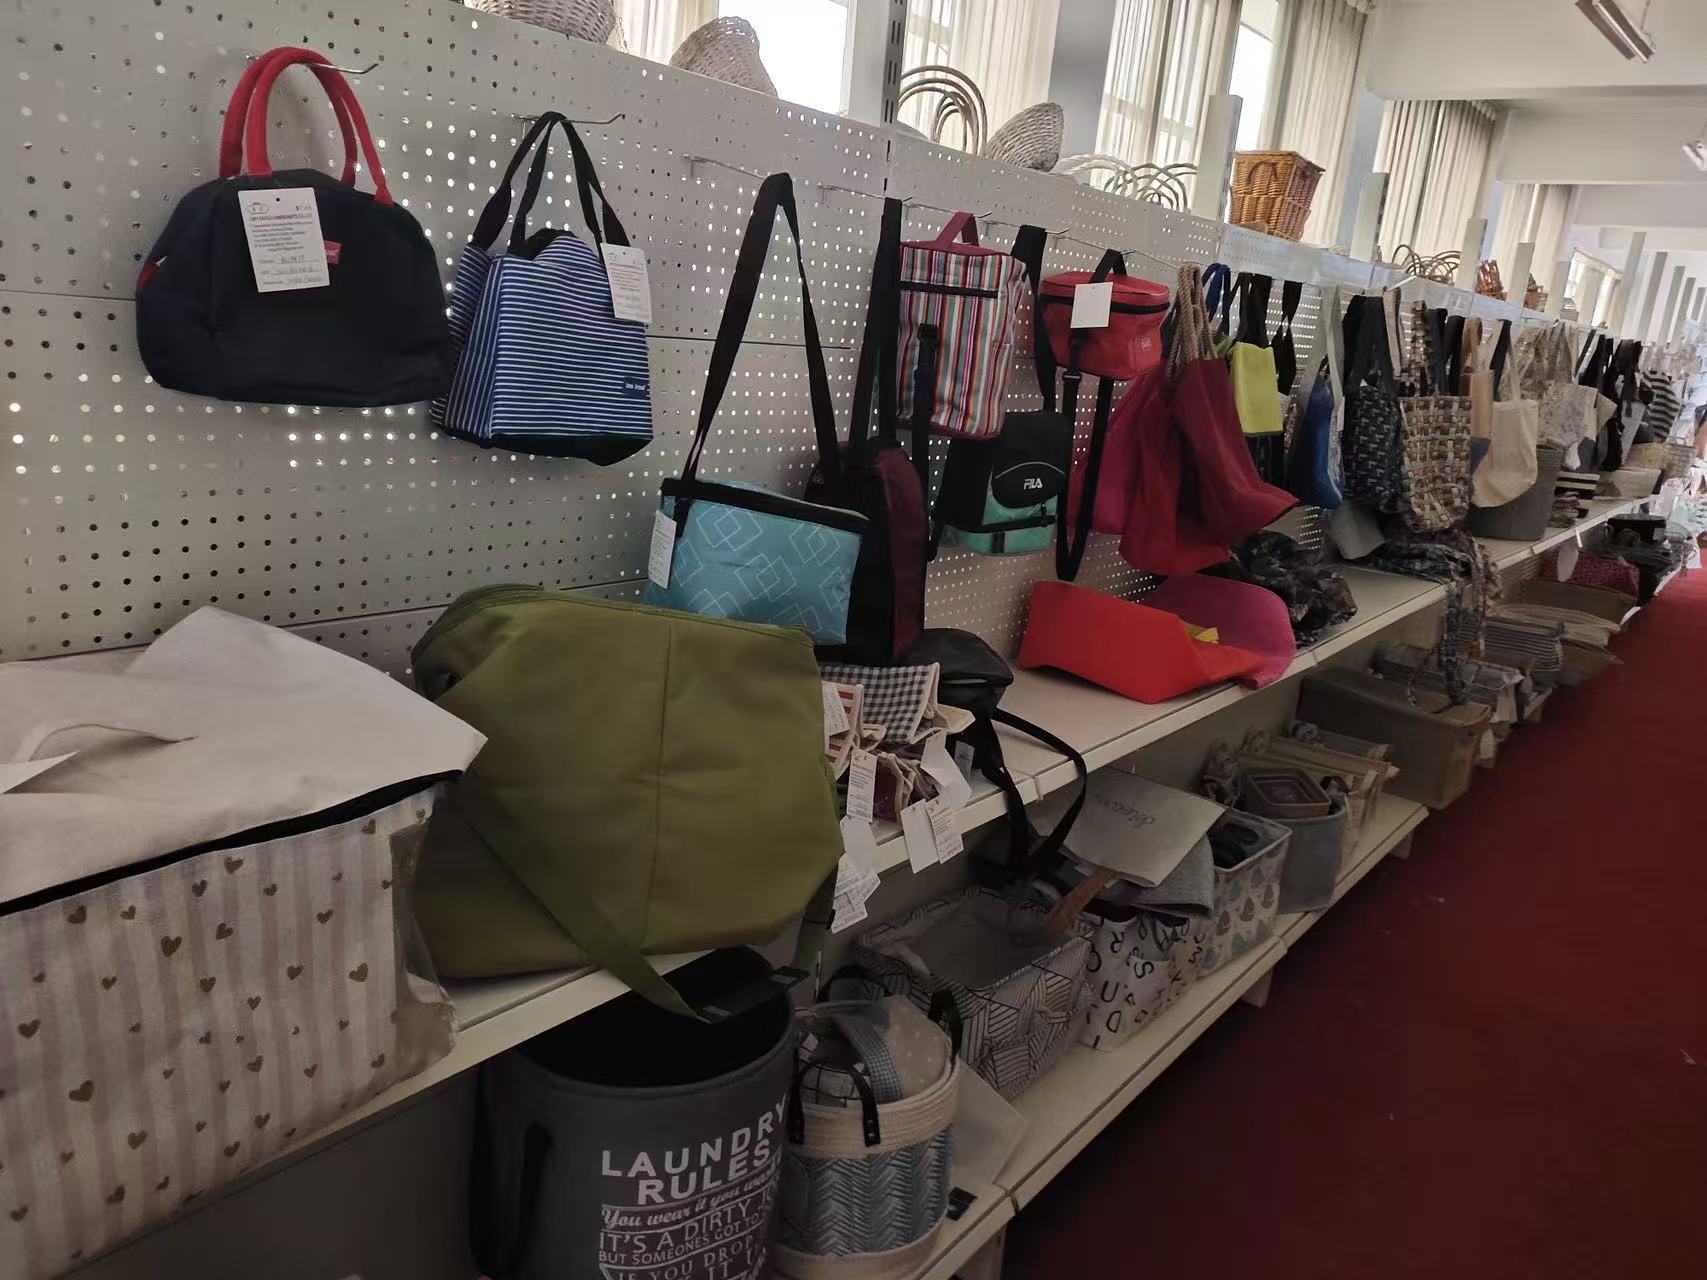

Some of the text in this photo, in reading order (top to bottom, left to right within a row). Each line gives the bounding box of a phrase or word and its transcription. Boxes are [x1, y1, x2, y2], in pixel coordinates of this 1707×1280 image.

[1023, 477, 1044, 490] FILA
[601, 1093, 786, 1178] LAUNDRY
[637, 1138, 770, 1205] RULES
[599, 1212, 760, 1266] BUT SOMEONES GOT TO
[600, 1231, 647, 1254] IT'S
[656, 1231, 674, 1252] A
[684, 1198, 752, 1242] DIRTY
[601, 1207, 641, 1230] You
[646, 1206, 691, 1227] wear
[649, 1260, 693, 1280] YOU
[703, 1235, 753, 1268] DROP
